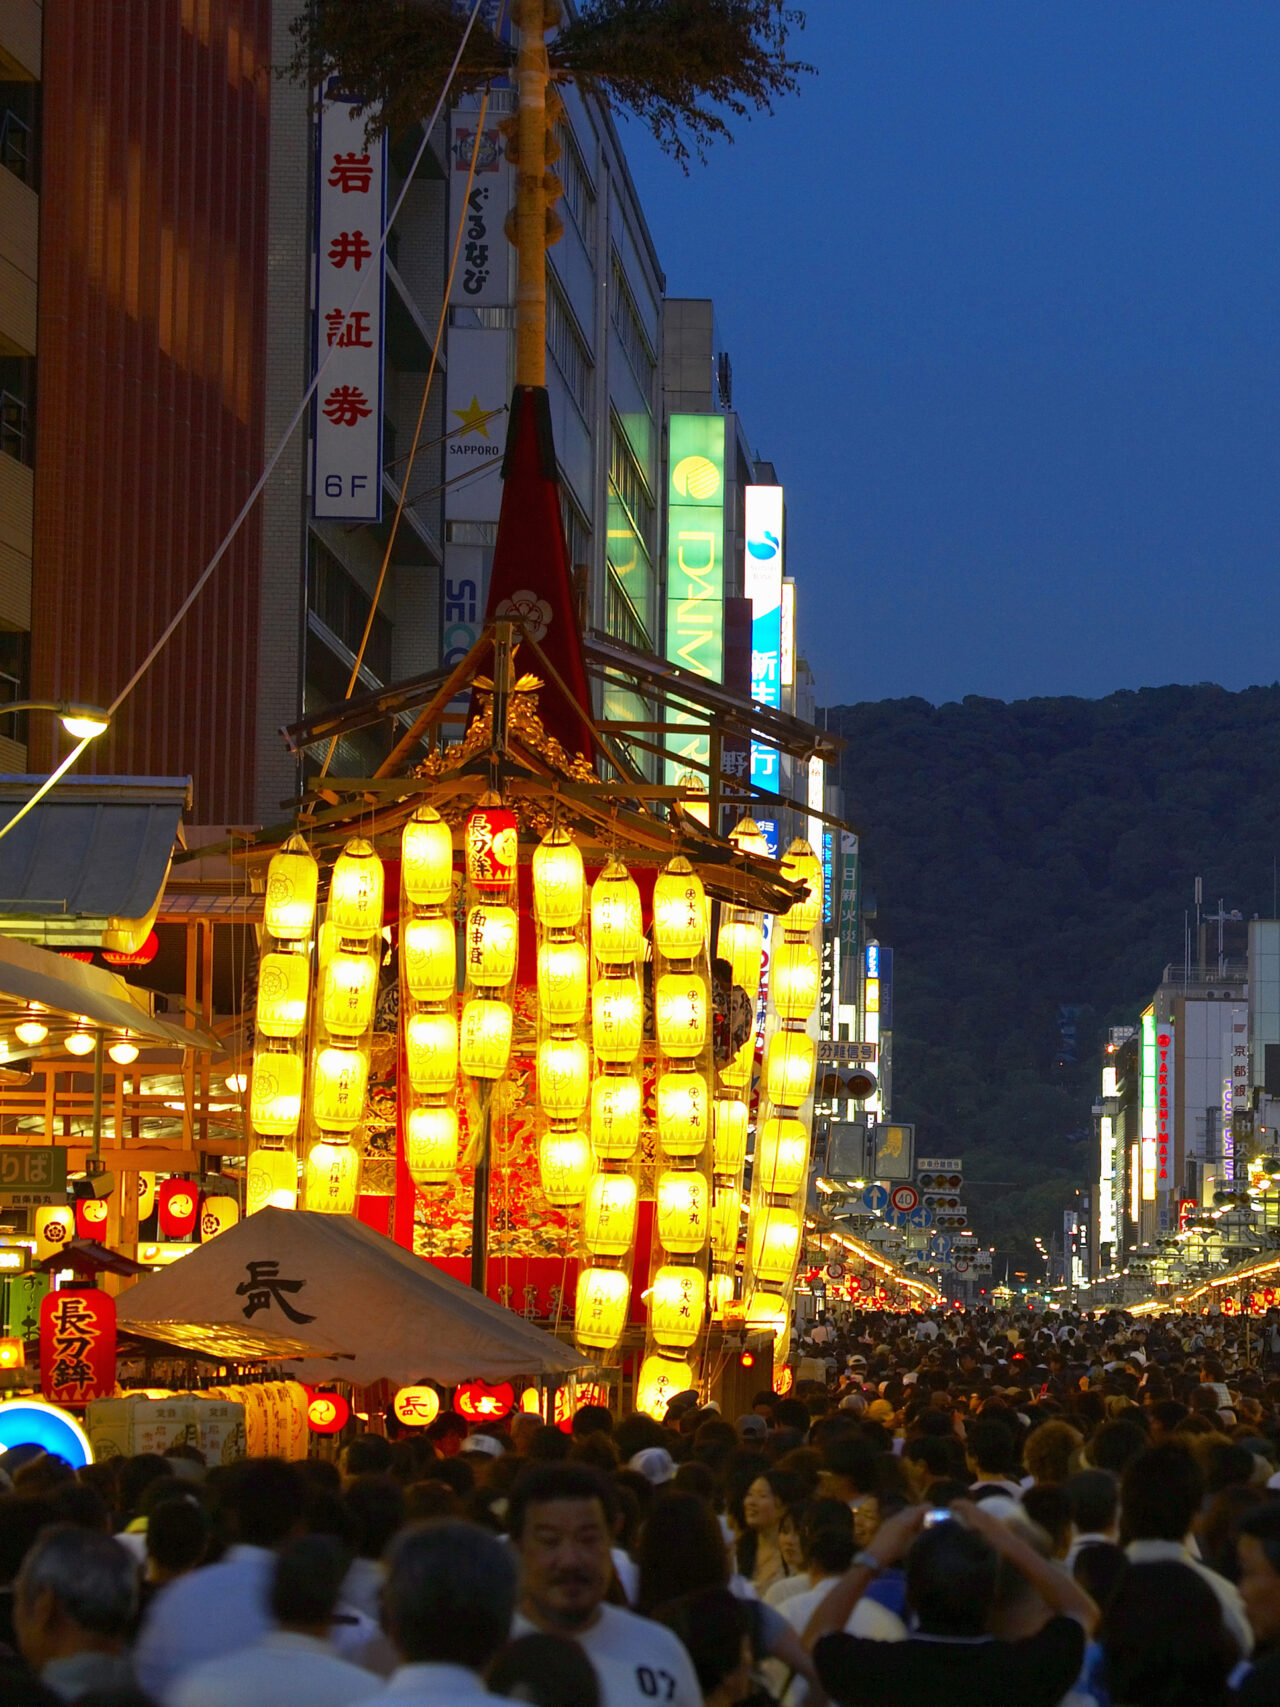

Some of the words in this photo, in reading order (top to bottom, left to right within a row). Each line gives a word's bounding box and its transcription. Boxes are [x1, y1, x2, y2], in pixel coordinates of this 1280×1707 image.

[463, 187, 490, 295] ぐるなび
[322, 152, 374, 427] 岩井証券
[450, 444, 499, 456] SAPPORO
[324, 474, 368, 498] 6F
[750, 649, 778, 776] 新生行
[470, 815, 490, 878] 長刀鉾
[687, 901, 697, 929] 大丸
[841, 867, 857, 944] 日新火災
[688, 1003, 698, 1031] 大丸
[820, 1044, 873, 1060] 分離信号
[689, 1100, 701, 1128] 大丸
[1158, 1050, 1169, 1179] TAKASHIMAYA
[689, 1198, 700, 1226] 大丸
[898, 1193, 911, 1206] 40
[235, 1260, 318, 1325] 長
[680, 1291, 691, 1319] 大丸
[52, 1298, 97, 1391] 長刀鉾
[634, 1666, 676, 1703] 07
